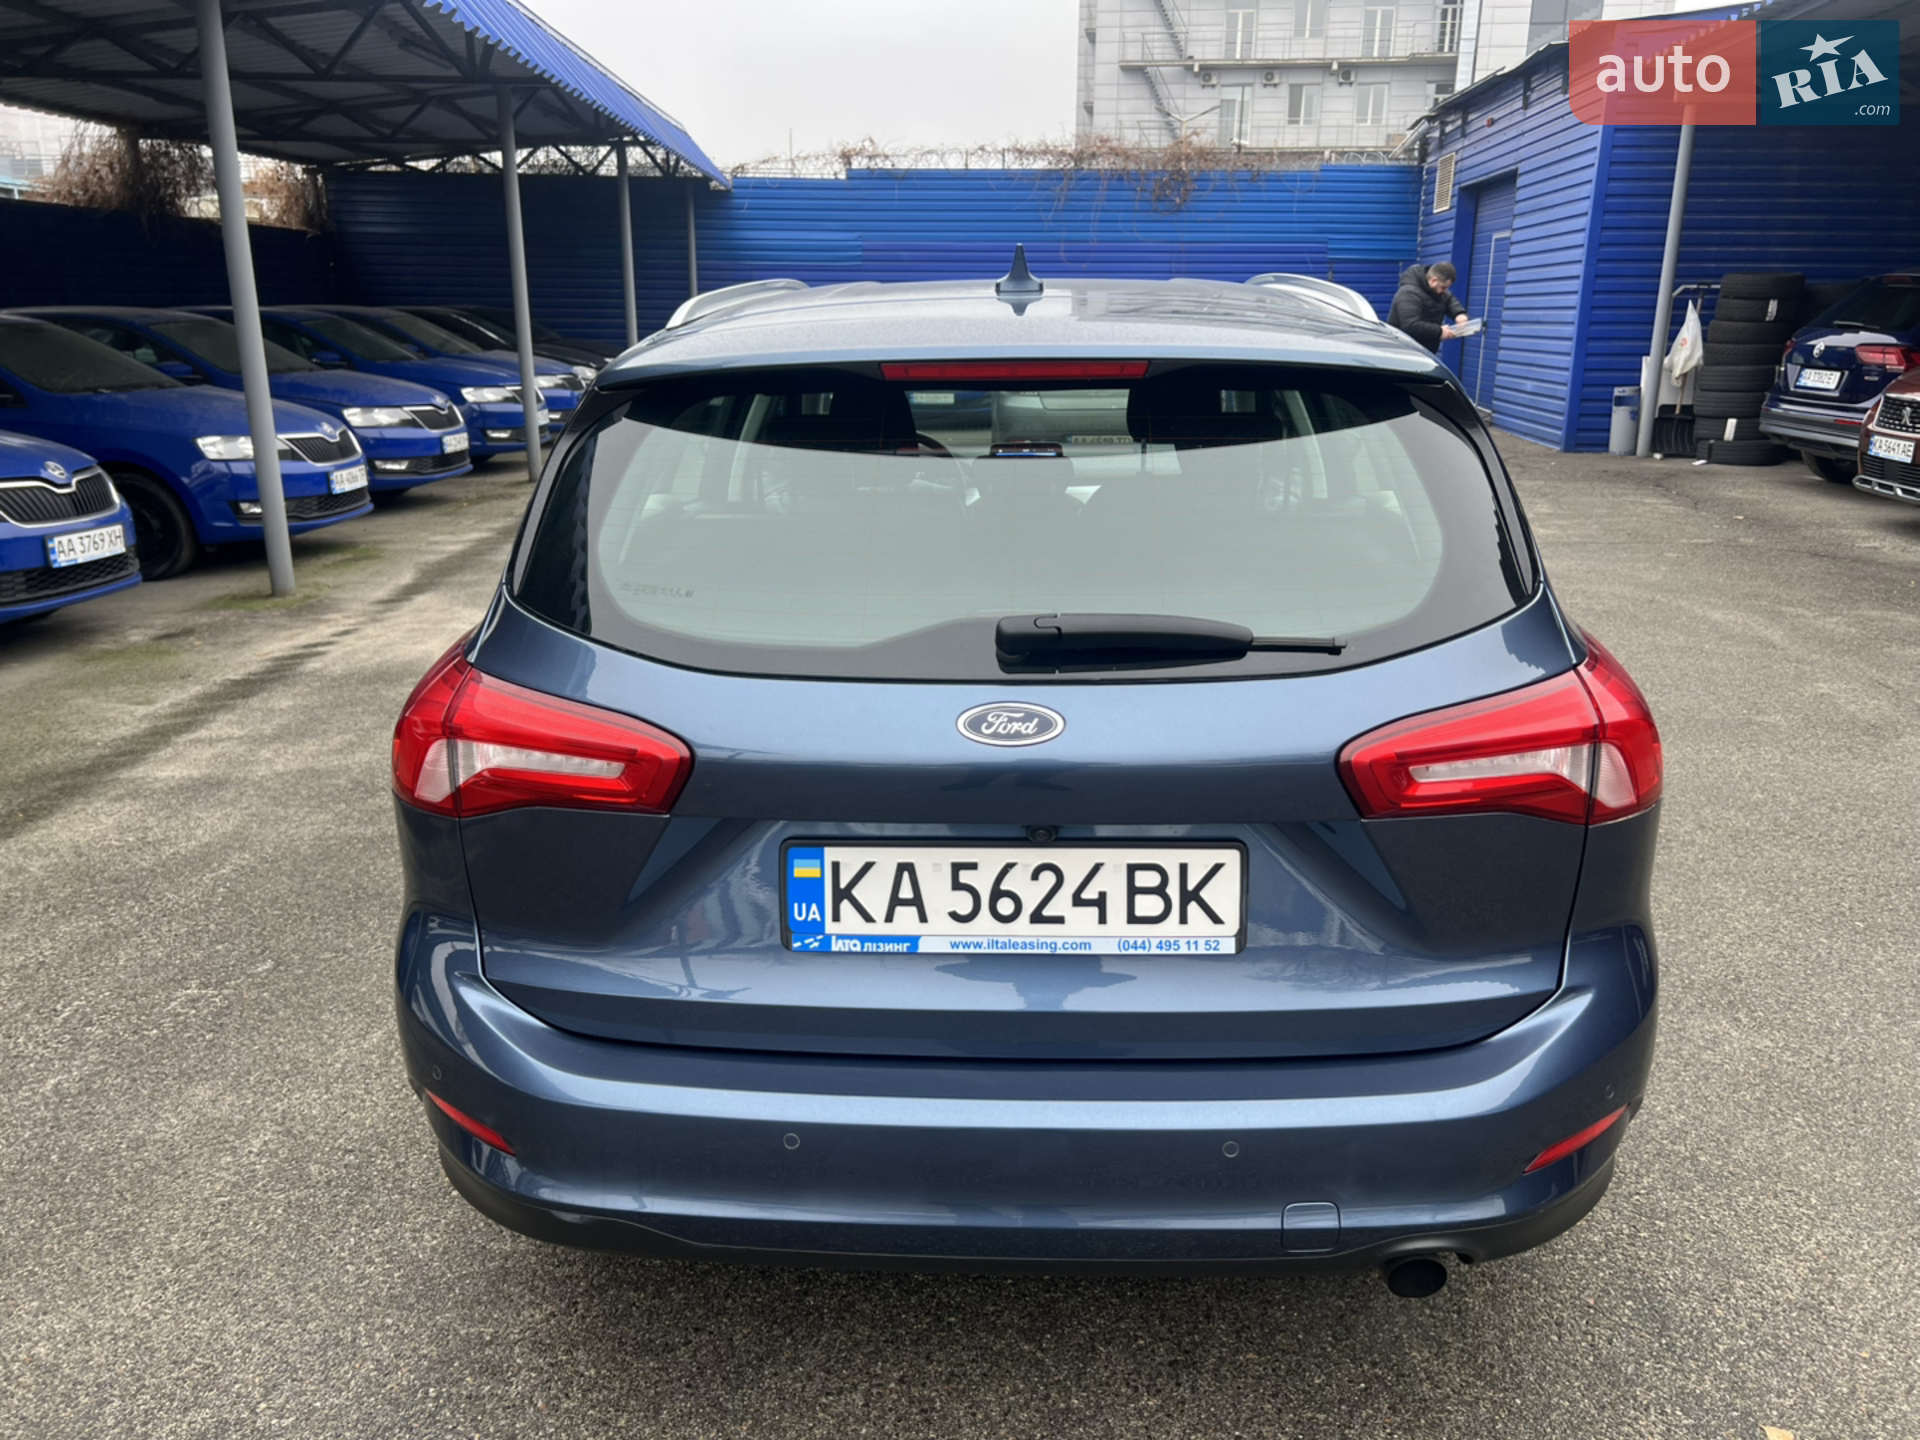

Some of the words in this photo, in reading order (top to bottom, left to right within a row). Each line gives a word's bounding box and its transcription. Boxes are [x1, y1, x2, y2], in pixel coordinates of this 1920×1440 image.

[1883, 439, 1902, 456] 5641
[57, 538, 77, 558] AA
[77, 532, 106, 554] 3769
[106, 527, 122, 549] XH
[981, 711, 1039, 734] Ford
[831, 860, 929, 923] KA
[947, 862, 1108, 925] 5624
[1126, 862, 1226, 925] BK
[793, 902, 822, 922] UA
[949, 938, 1092, 953] www.iltaleasing.com
[1117, 938, 1152, 952] (044)
[1156, 940, 1181, 952] 495
[1185, 940, 1199, 952] 11
[1204, 940, 1221, 952] 52
